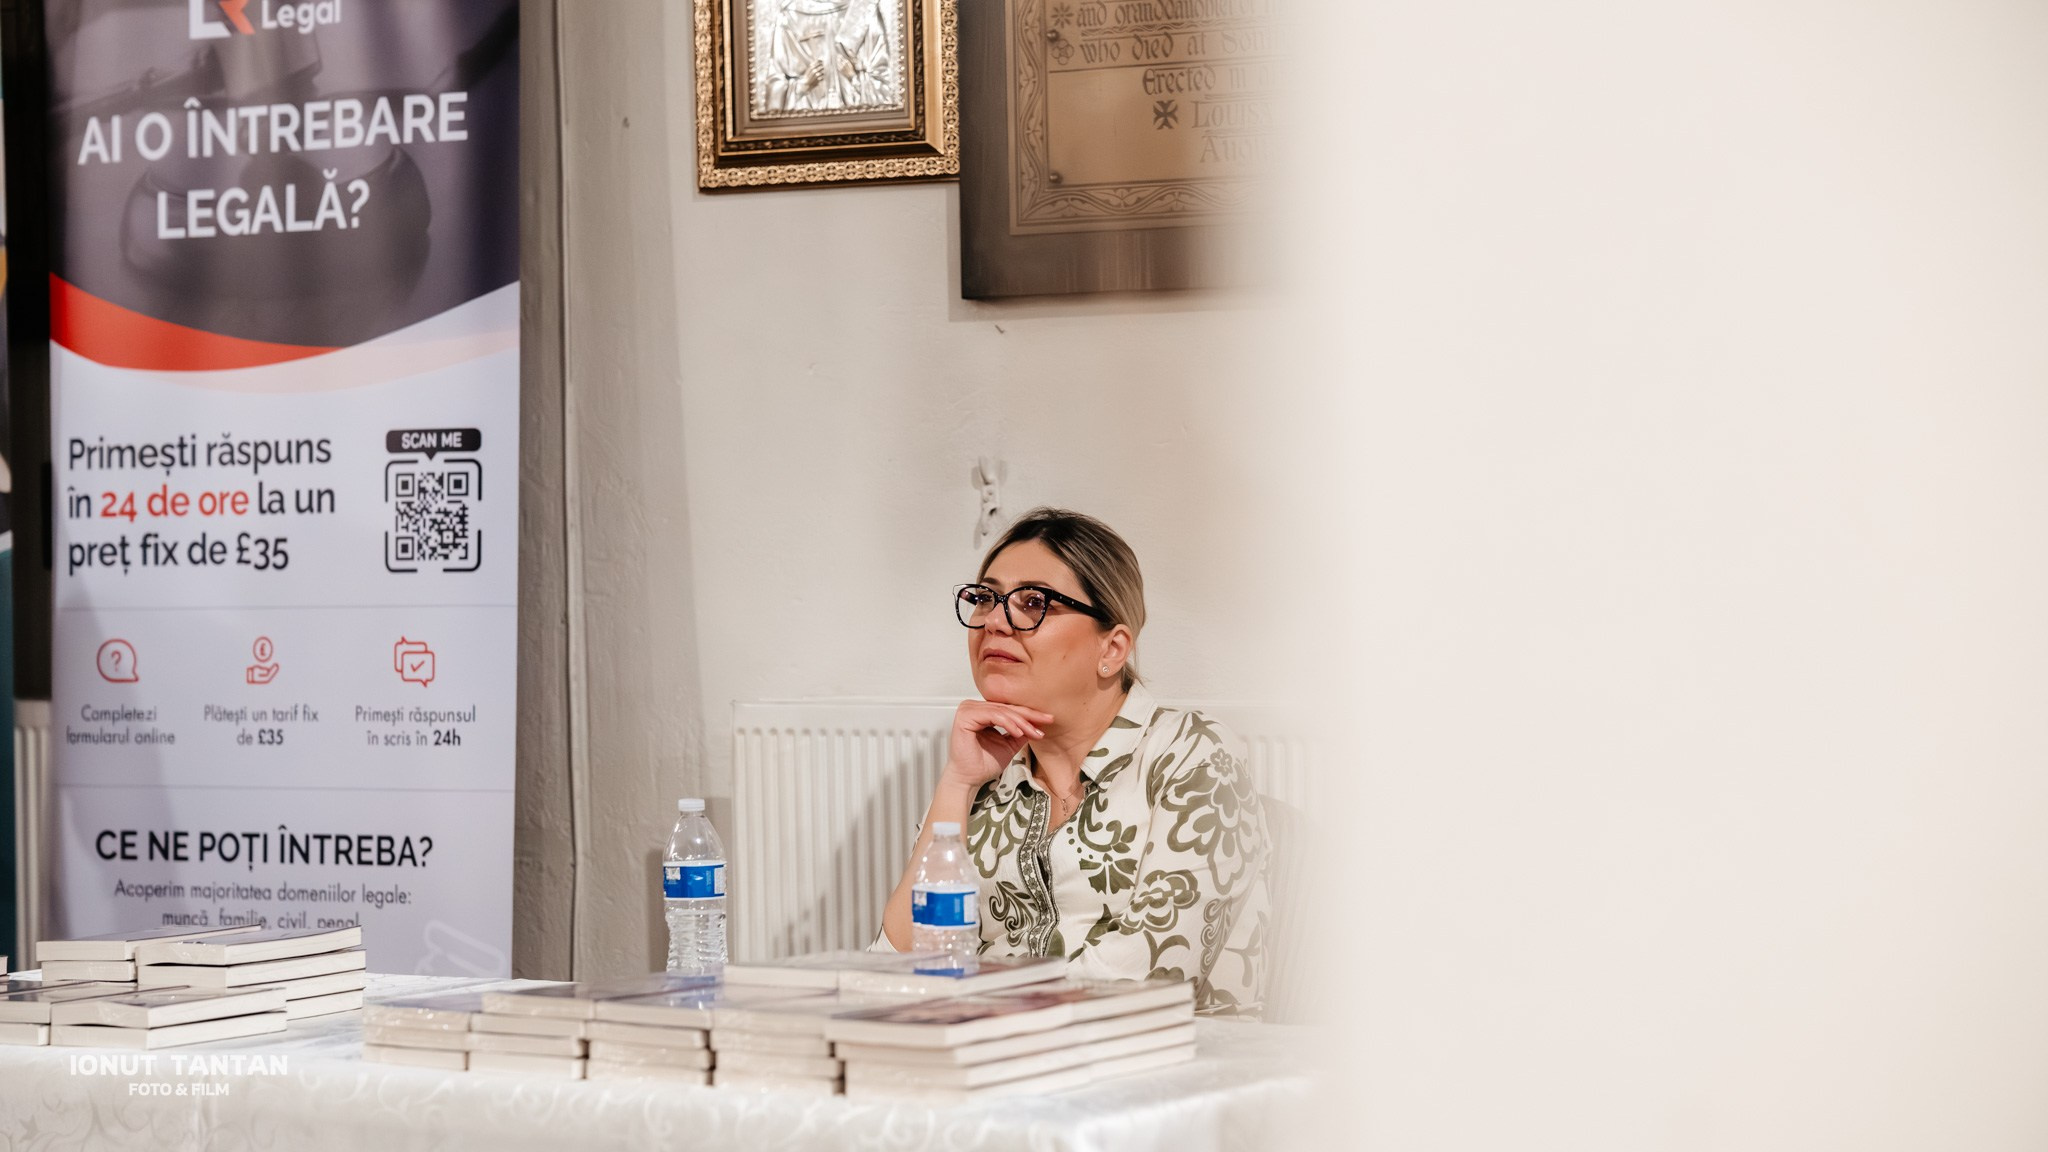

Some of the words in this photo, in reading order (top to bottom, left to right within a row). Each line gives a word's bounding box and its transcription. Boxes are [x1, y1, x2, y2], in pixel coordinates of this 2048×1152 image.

[261, 0, 341, 34] Legal
[1076, 0, 1107, 27] and
[1079, 38, 1121, 64] who
[1131, 31, 1175, 61] died
[1187, 32, 1208, 57] at
[1142, 64, 1217, 95] Erected
[78, 114, 121, 166] AI
[134, 111, 173, 161] O
[184, 92, 469, 159] ÎNTREBARE
[157, 168, 370, 240] LEGALĂ?
[69, 434, 196, 477] Primești
[207, 432, 331, 475] răspuns
[401, 432, 438, 450] SCAN
[441, 431, 463, 448] ME
[67, 485, 91, 518] în
[100, 491, 137, 522] 24
[147, 483, 190, 517] de
[199, 490, 249, 517] ore
[258, 480, 285, 515] la
[295, 487, 335, 514] un
[69, 535, 131, 577] preț
[140, 532, 179, 567] fix
[187, 532, 227, 566] de
[236, 531, 289, 571] £35
[80, 704, 157, 726] Completezi
[203, 704, 248, 727] Plătești
[252, 709, 267, 722] un
[272, 703, 299, 722] tarif
[302, 704, 319, 722] fix
[355, 704, 404, 727] Primești
[409, 704, 476, 727] răspunsul
[134, 726, 176, 746] online
[237, 727, 253, 746] de
[258, 728, 284, 746] £35
[367, 729, 379, 746] în
[384, 729, 412, 747] scris
[415, 729, 428, 746] în
[433, 728, 461, 746] 24h
[95, 830, 138, 862] CE
[148, 831, 190, 862] NE
[199, 832, 268, 872] POȚI
[278, 824, 433, 868] ÎNTREBA?
[114, 878, 185, 902] Acoperim
[190, 880, 272, 903] majoritatea
[277, 881, 356, 903] domeniilor
[362, 883, 412, 910] legale:
